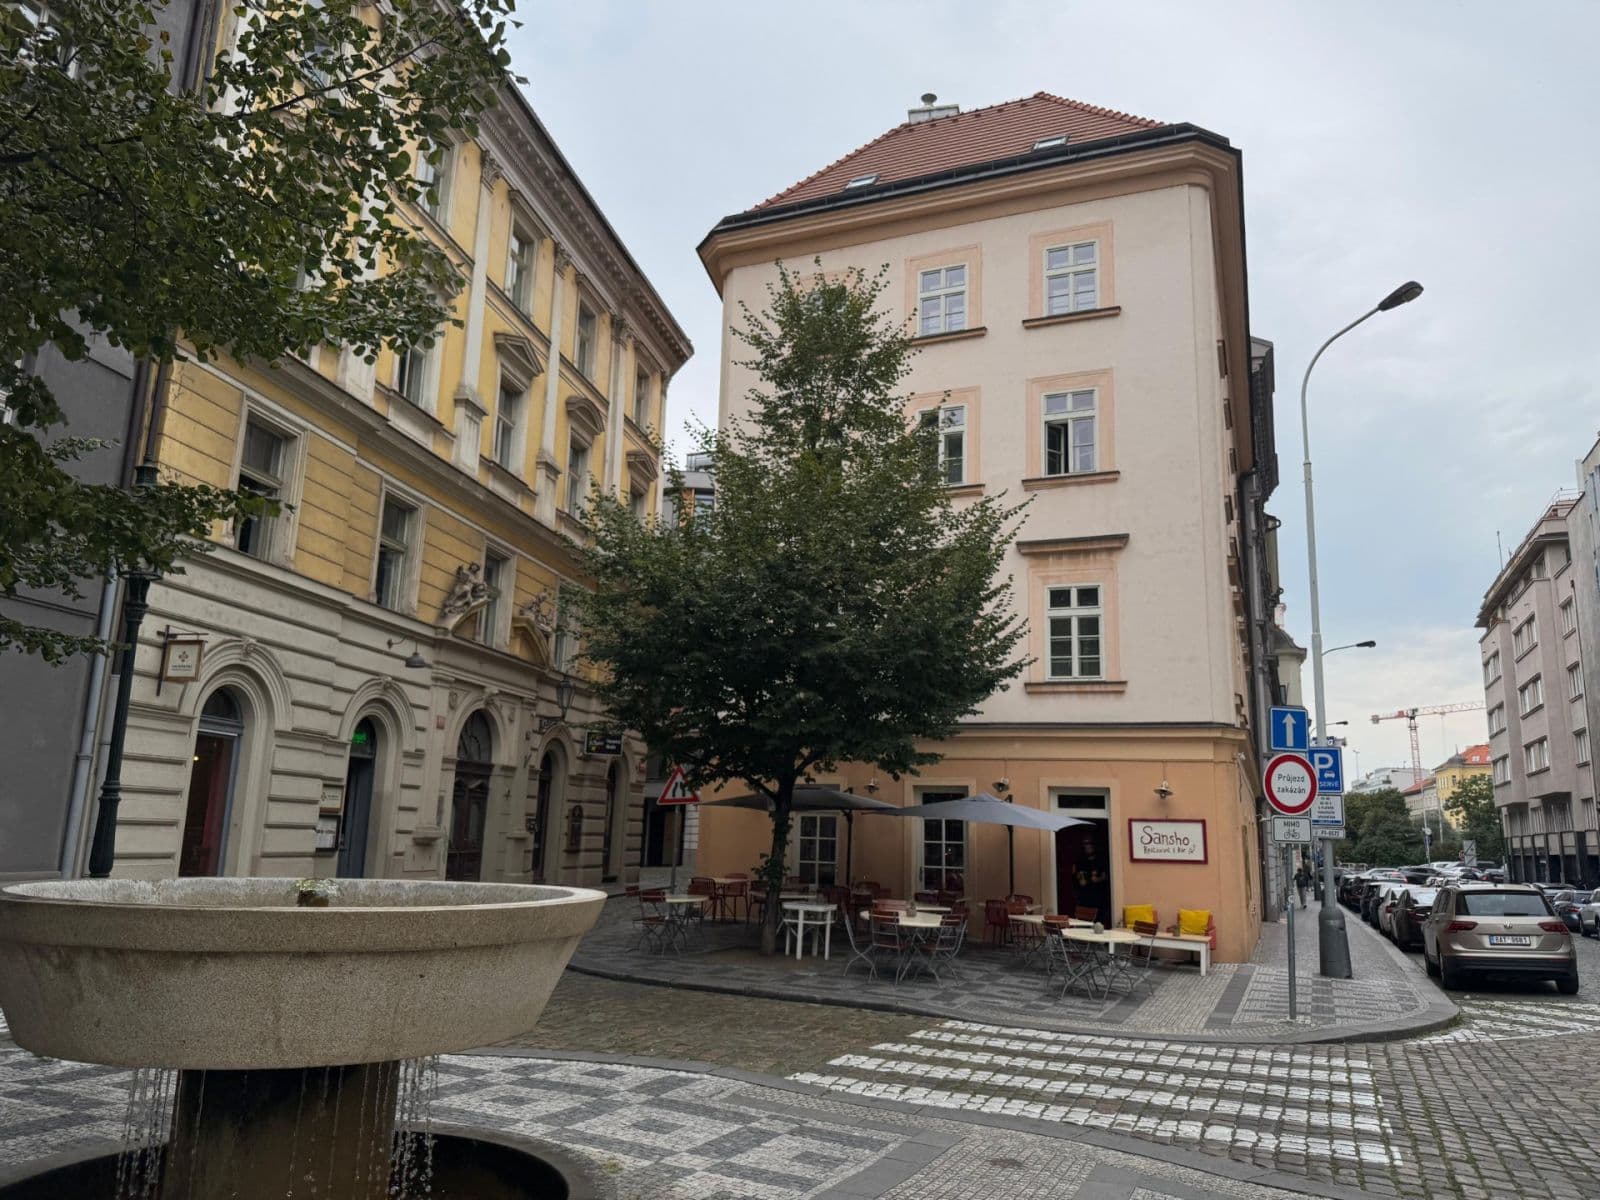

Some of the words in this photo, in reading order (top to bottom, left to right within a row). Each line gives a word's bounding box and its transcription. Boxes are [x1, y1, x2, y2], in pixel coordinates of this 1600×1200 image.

[1313, 753, 1334, 779] P
[1277, 773, 1305, 783] Průjezd
[1277, 784, 1306, 794] zakázán
[1283, 820, 1300, 828] MIMO
[1140, 825, 1190, 846] Sansho
